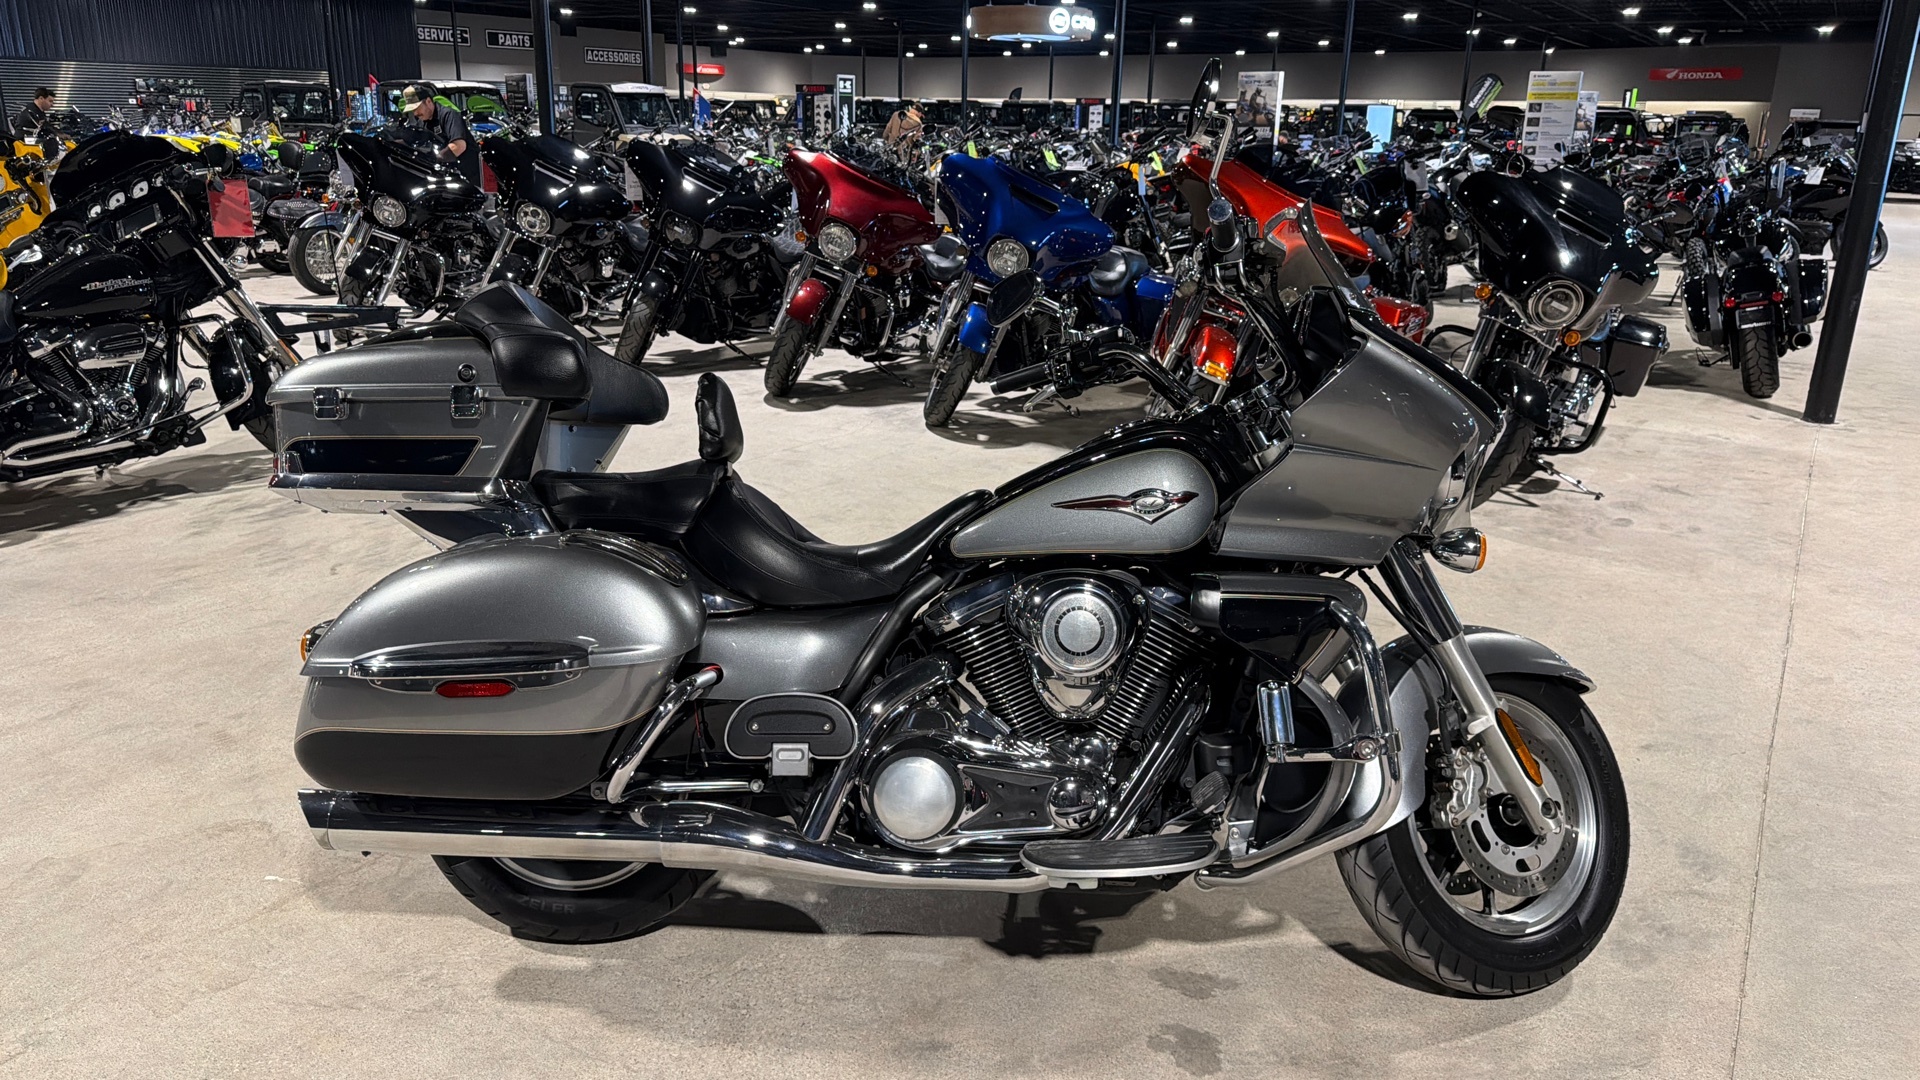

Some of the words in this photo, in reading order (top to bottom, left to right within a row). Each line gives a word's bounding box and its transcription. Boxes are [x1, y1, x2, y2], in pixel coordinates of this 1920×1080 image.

[417, 27, 462, 43] SERVICE
[498, 33, 531, 47] PARTS
[587, 50, 641, 64] ACCESSORIES
[1678, 71, 1723, 80] HONDA
